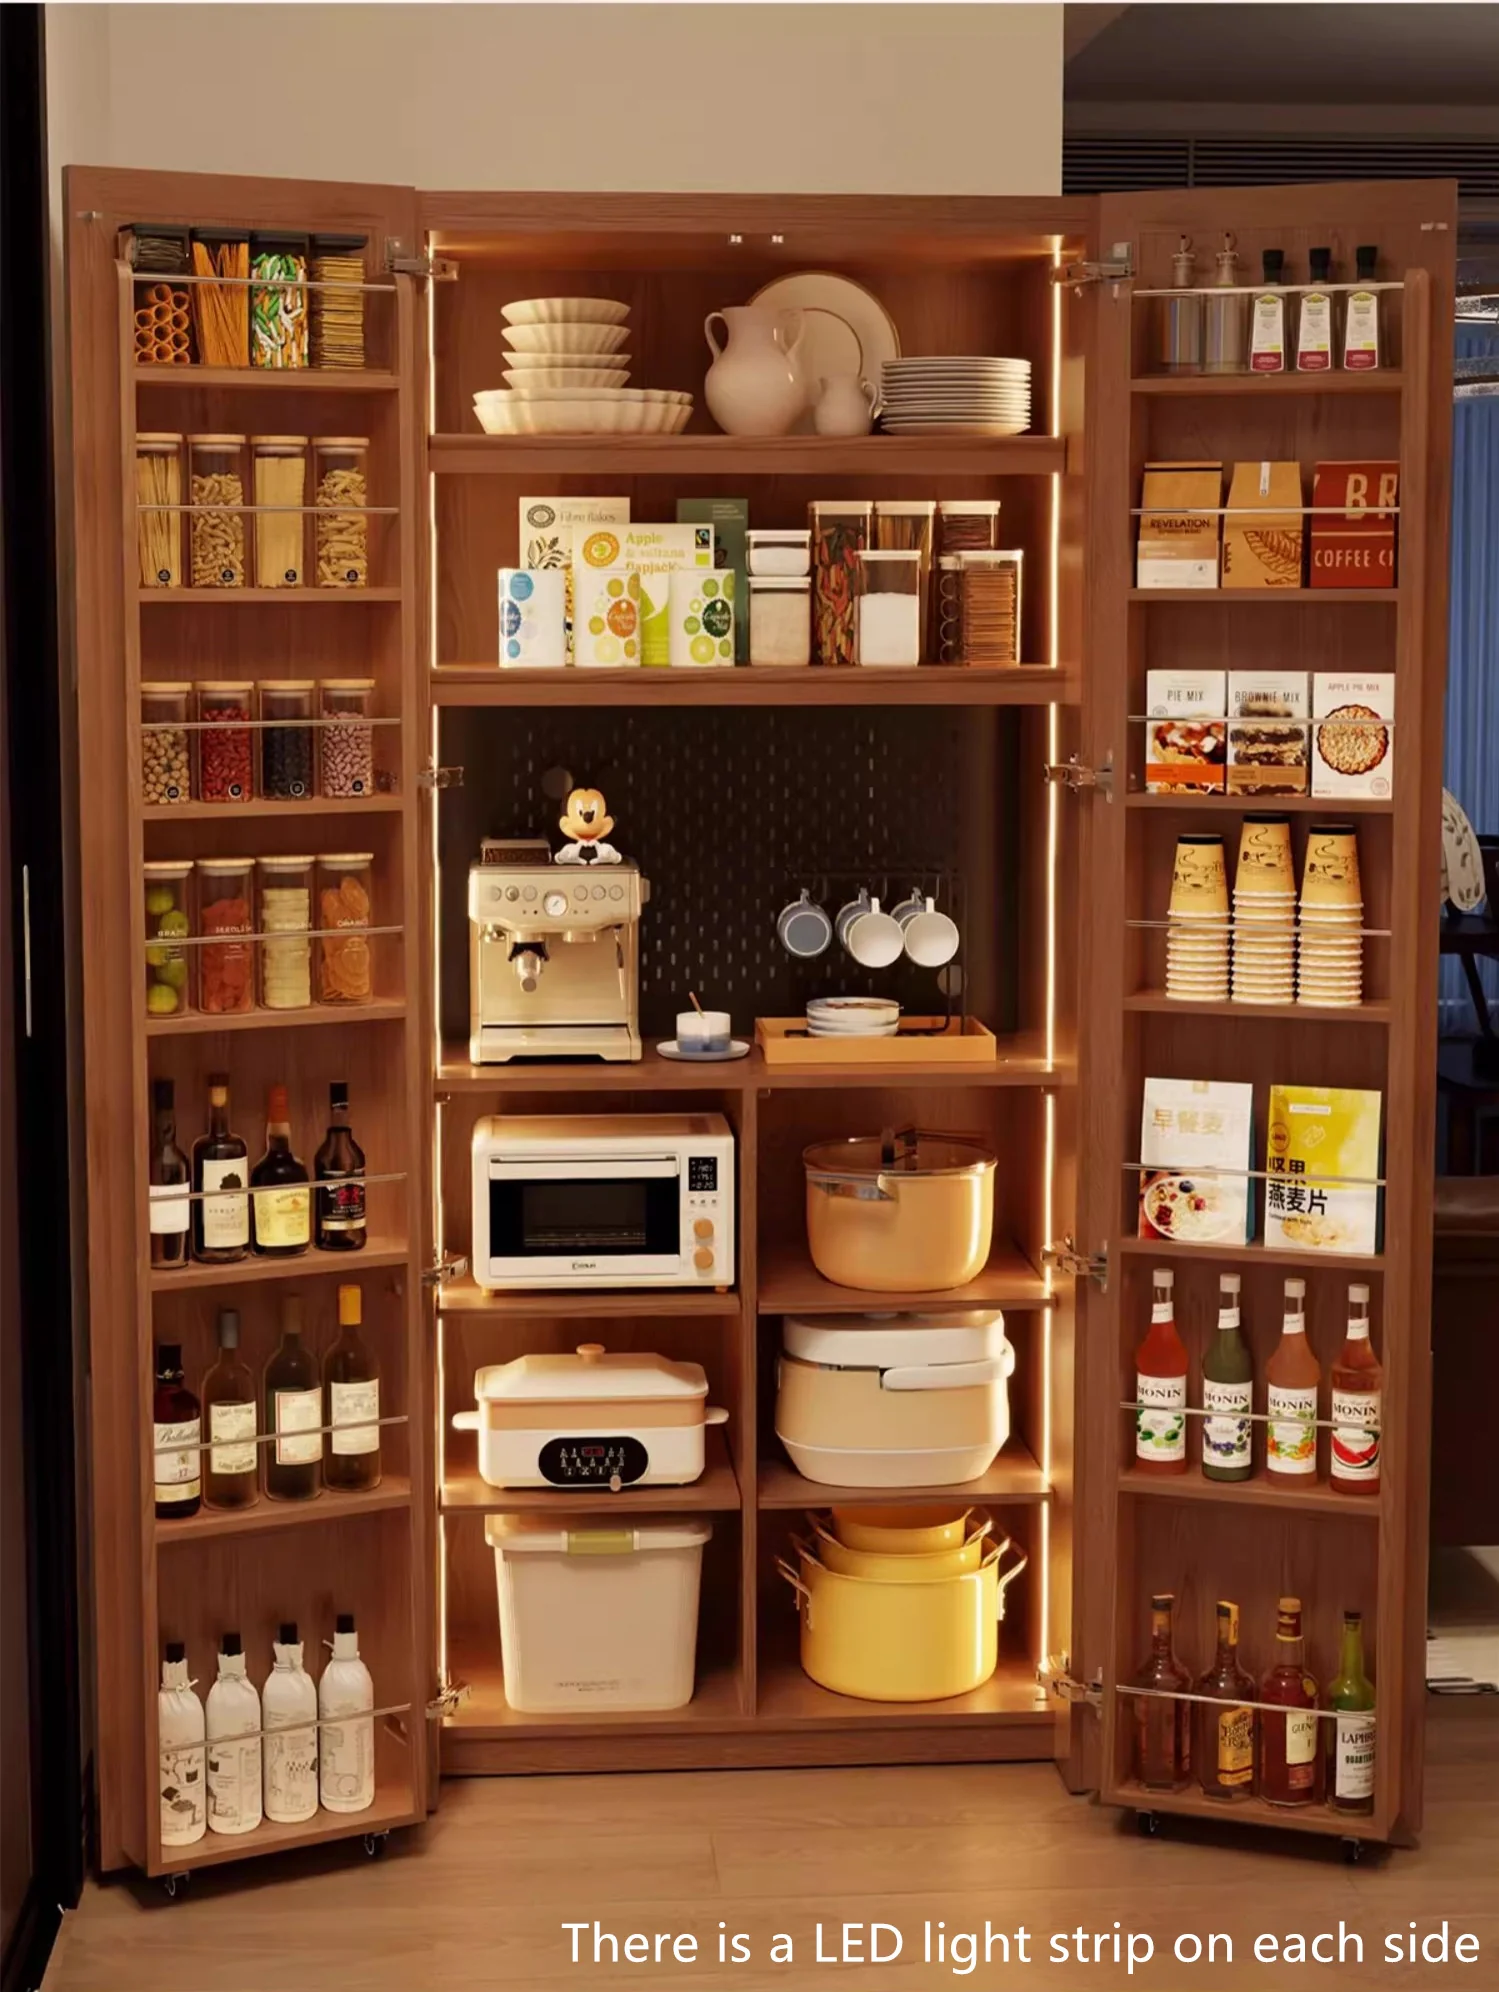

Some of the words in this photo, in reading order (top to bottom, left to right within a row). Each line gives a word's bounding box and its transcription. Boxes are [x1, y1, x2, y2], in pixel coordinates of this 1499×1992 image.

[1150, 519, 1210, 528] REVELATION
[626, 532, 663, 546] Apple
[1315, 550, 1371, 567] COFFEE
[1328, 683, 1350, 691] APPLE
[1352, 683, 1363, 692] PIE
[1366, 684, 1380, 692] MIX
[1167, 690, 1182, 701] PIE
[1187, 690, 1204, 701] MIX
[1234, 691, 1277, 703] BROWNIE
[1283, 692, 1300, 702] MIX
[1268, 1183, 1328, 1216] 燕麦片
[1139, 1386, 1181, 1398] MONIN
[1205, 1393, 1248, 1404] MONIN
[1269, 1397, 1312, 1410] MONIN
[1334, 1403, 1376, 1416] MONIN
